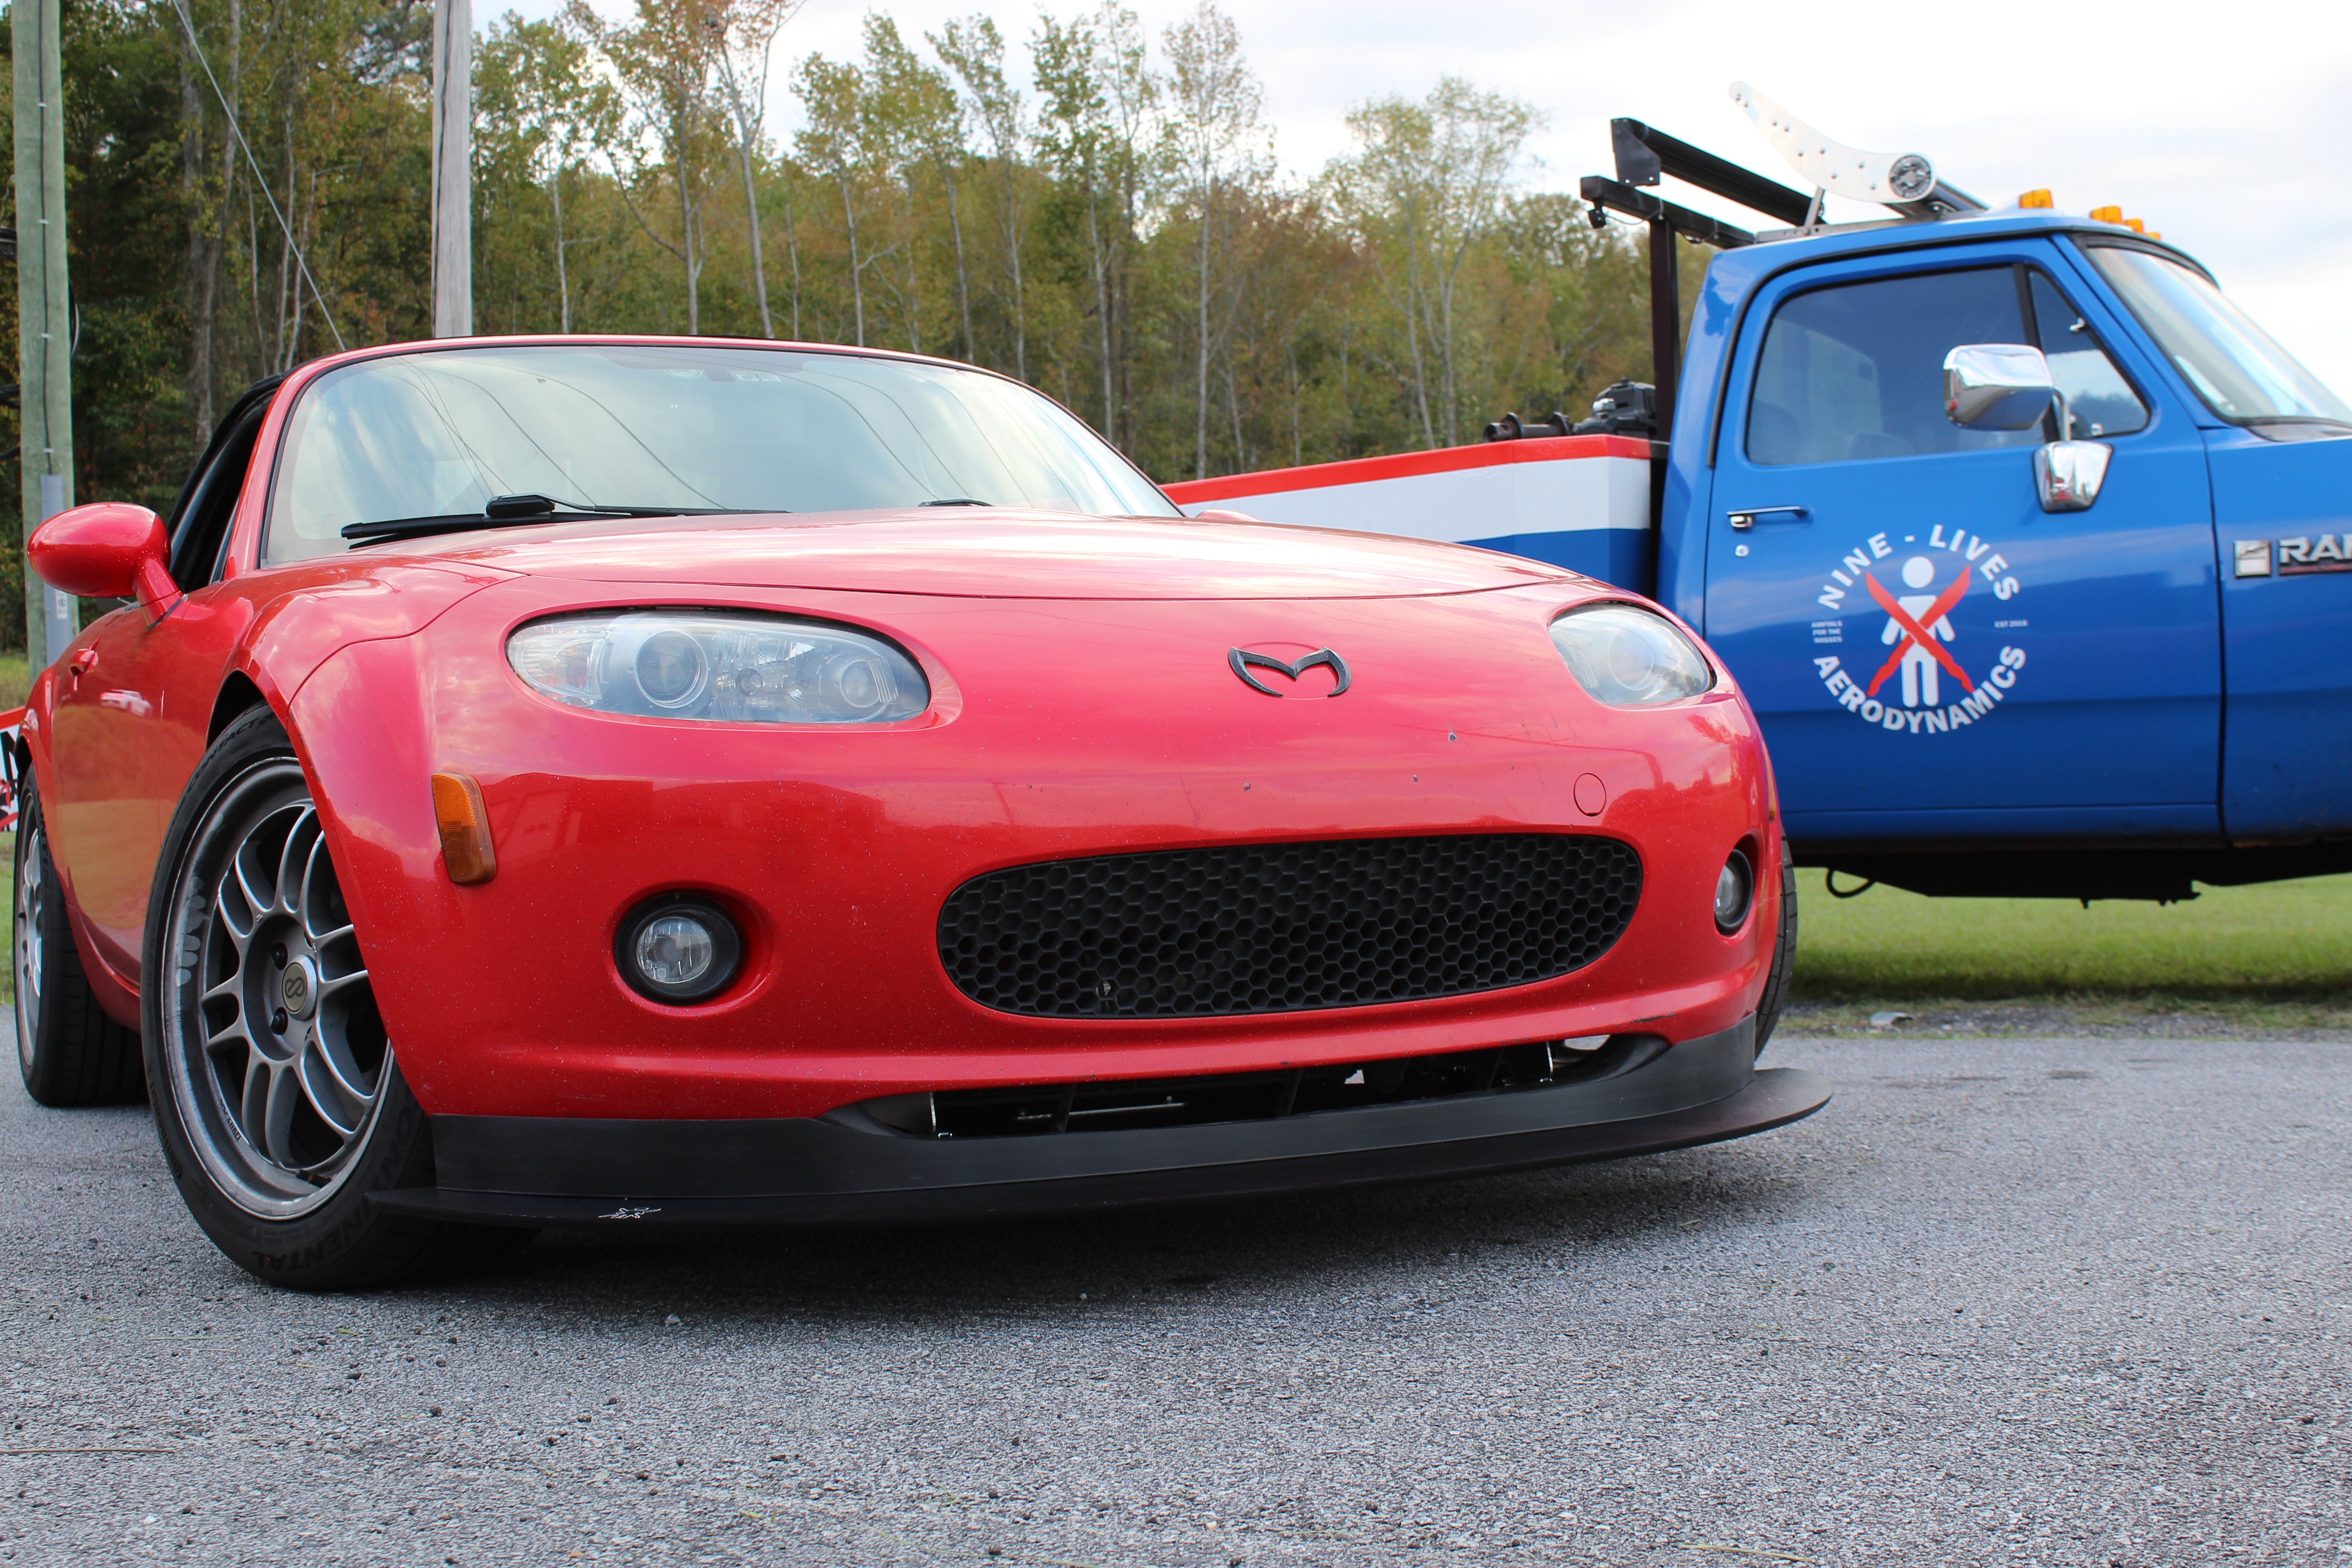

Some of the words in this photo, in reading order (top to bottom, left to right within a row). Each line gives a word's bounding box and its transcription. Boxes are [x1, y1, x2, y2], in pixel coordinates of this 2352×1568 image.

[1817, 532, 1893, 610] NINE
[1929, 524, 2020, 601] LIVES
[1813, 646, 2026, 734] AERODYNAMICS
